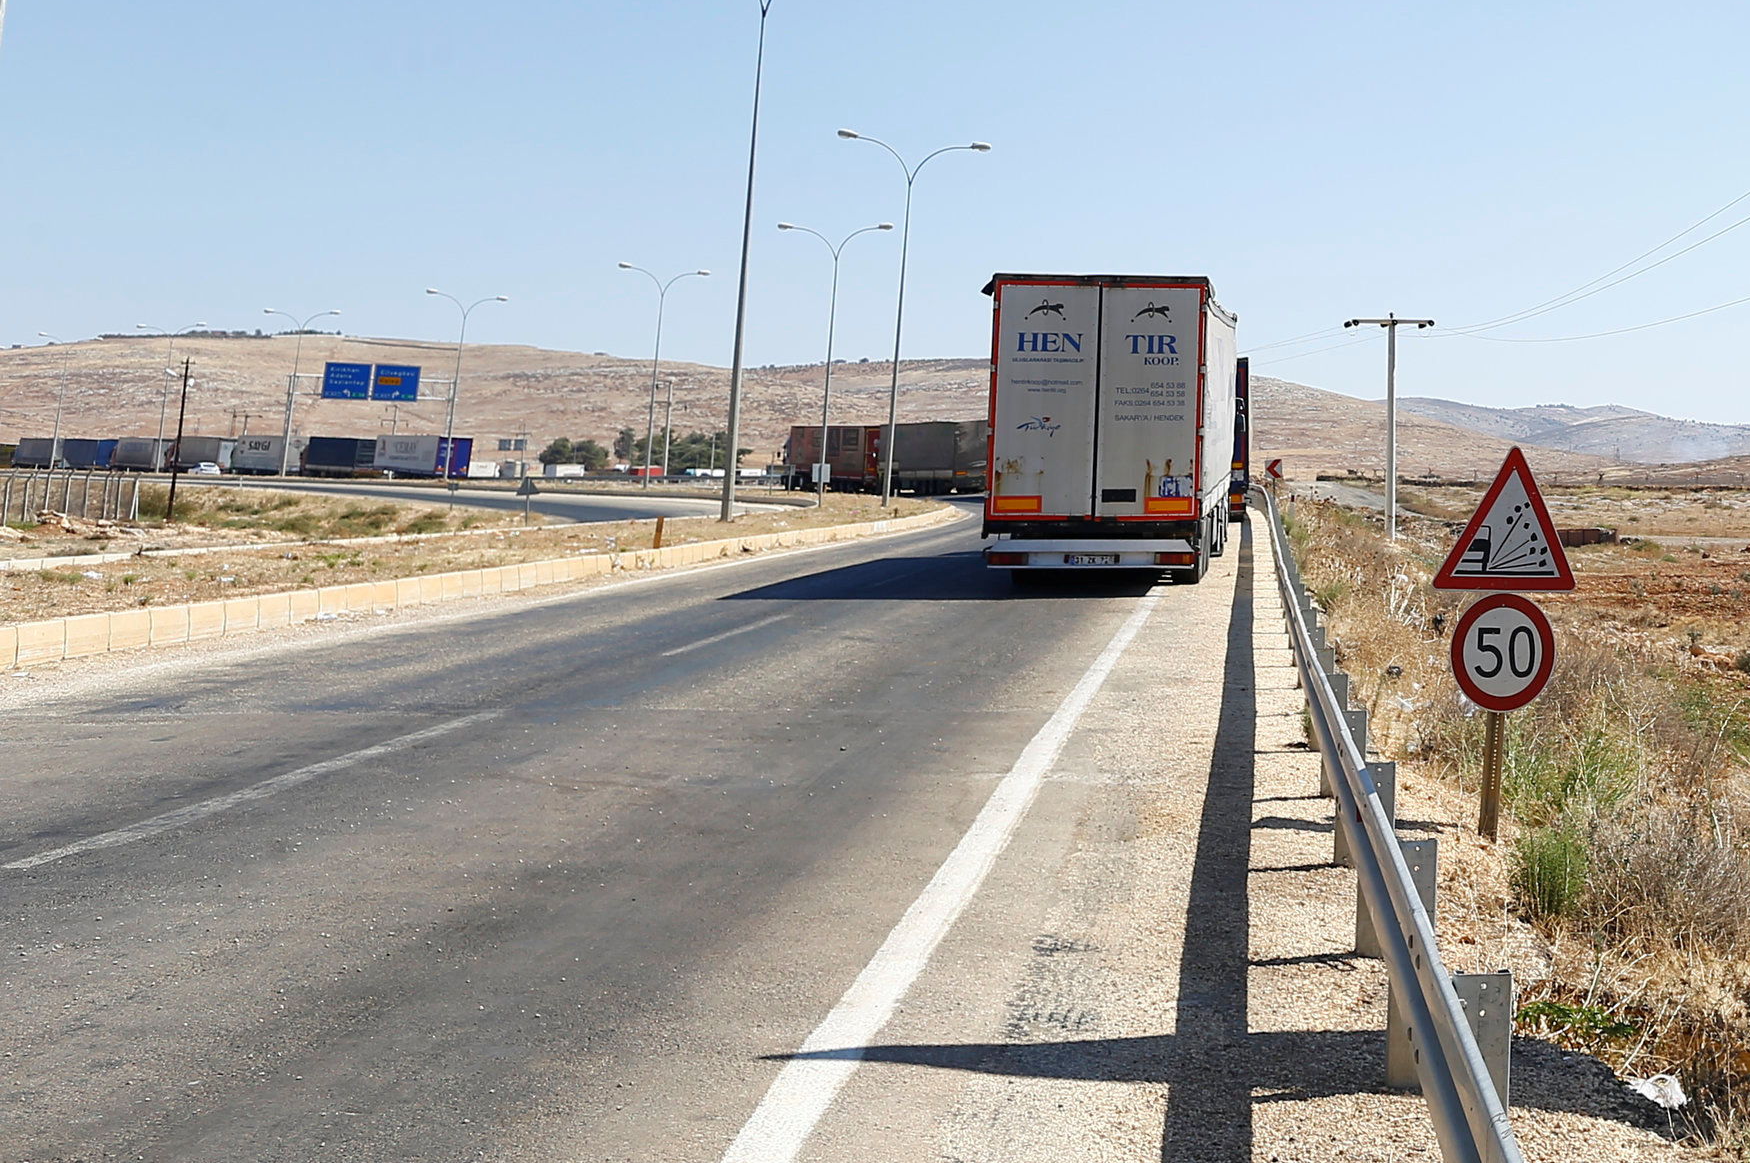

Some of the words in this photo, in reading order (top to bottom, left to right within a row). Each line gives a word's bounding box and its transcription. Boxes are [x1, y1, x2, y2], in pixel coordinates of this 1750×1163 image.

[1017, 332, 1083, 353] HEN
[1124, 334, 1178, 355] TIR
[1114, 414, 1149, 422] SAKARYA
[1153, 414, 1185, 422] HENDEK
[1474, 625, 1537, 679] 50
